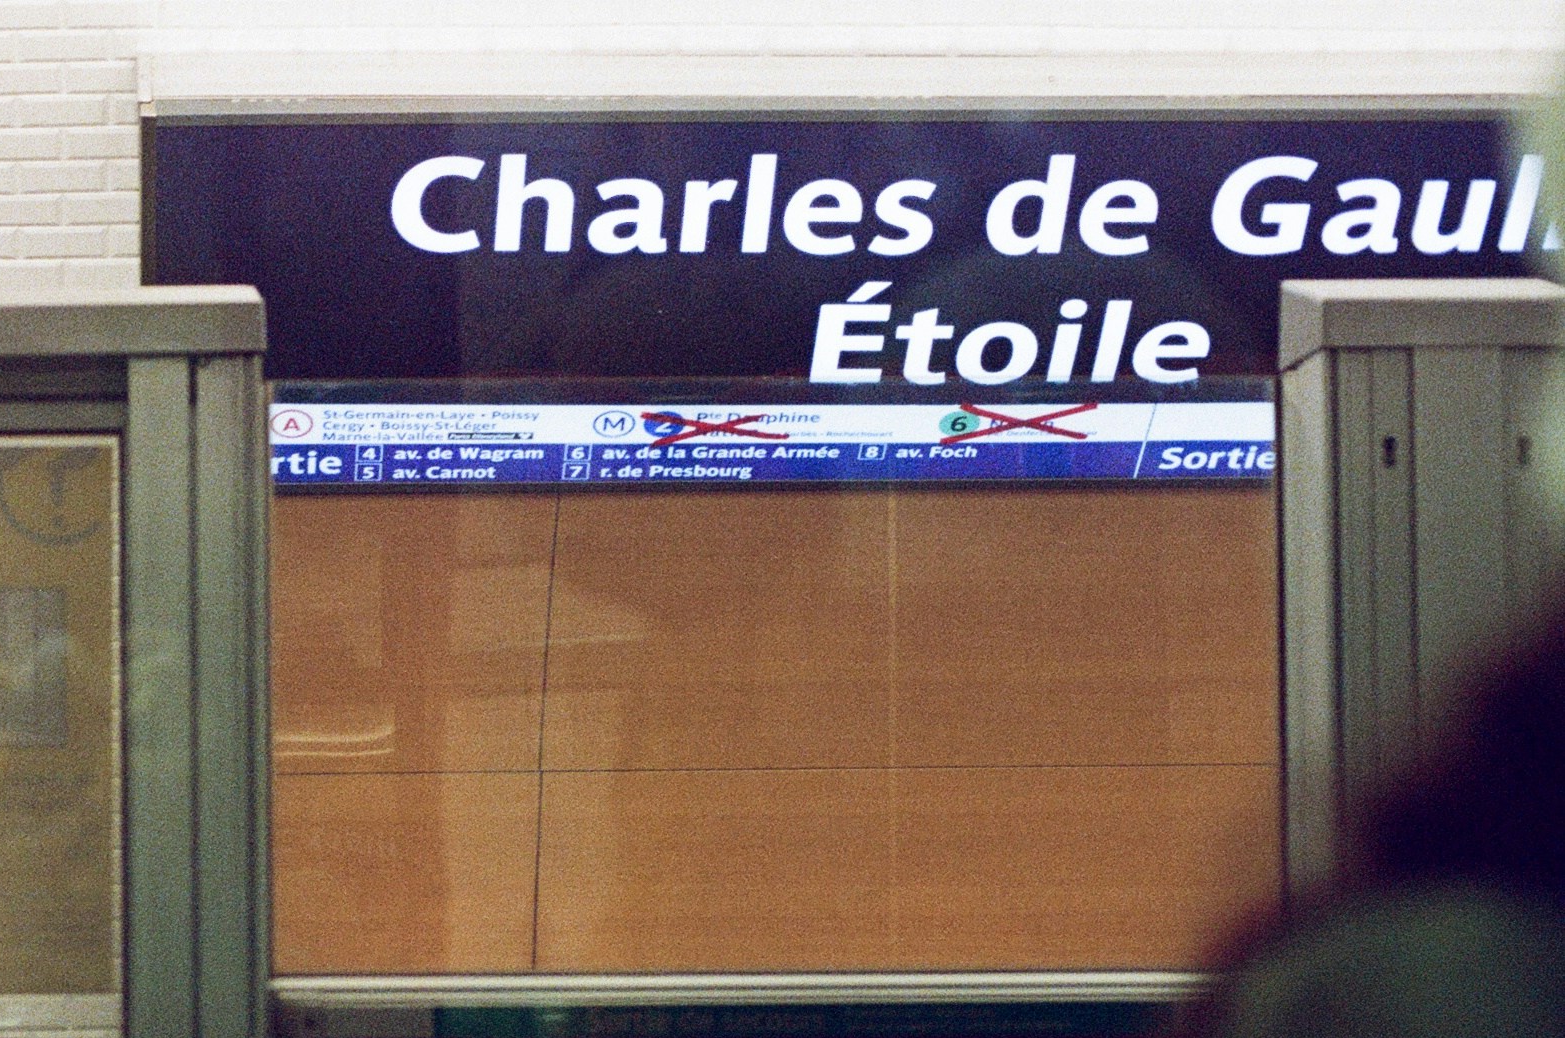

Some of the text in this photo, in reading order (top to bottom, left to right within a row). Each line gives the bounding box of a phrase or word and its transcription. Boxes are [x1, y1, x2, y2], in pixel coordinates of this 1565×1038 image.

[391, 153, 1561, 256] Charles de Gaul
[808, 280, 1211, 385] Étoile
[322, 410, 541, 421] St-Germain-en-Laye Poissy
[282, 417, 301, 431] A
[322, 420, 497, 432] Cergy Boissy-St-Léger
[602, 416, 626, 432] M
[950, 415, 968, 432] 6
[322, 431, 444, 441] Marne-la-Vallée
[362, 447, 545, 463] 4 av. de Wagram
[570, 445, 841, 460] 6 av. de la Grande Armée
[864, 445, 979, 459] 8 av. Foch
[1158, 445, 1276, 470] Sortie
[361, 466, 497, 479] 5 av. Carnot
[568, 465, 753, 480] 7 r. de Presbourg
